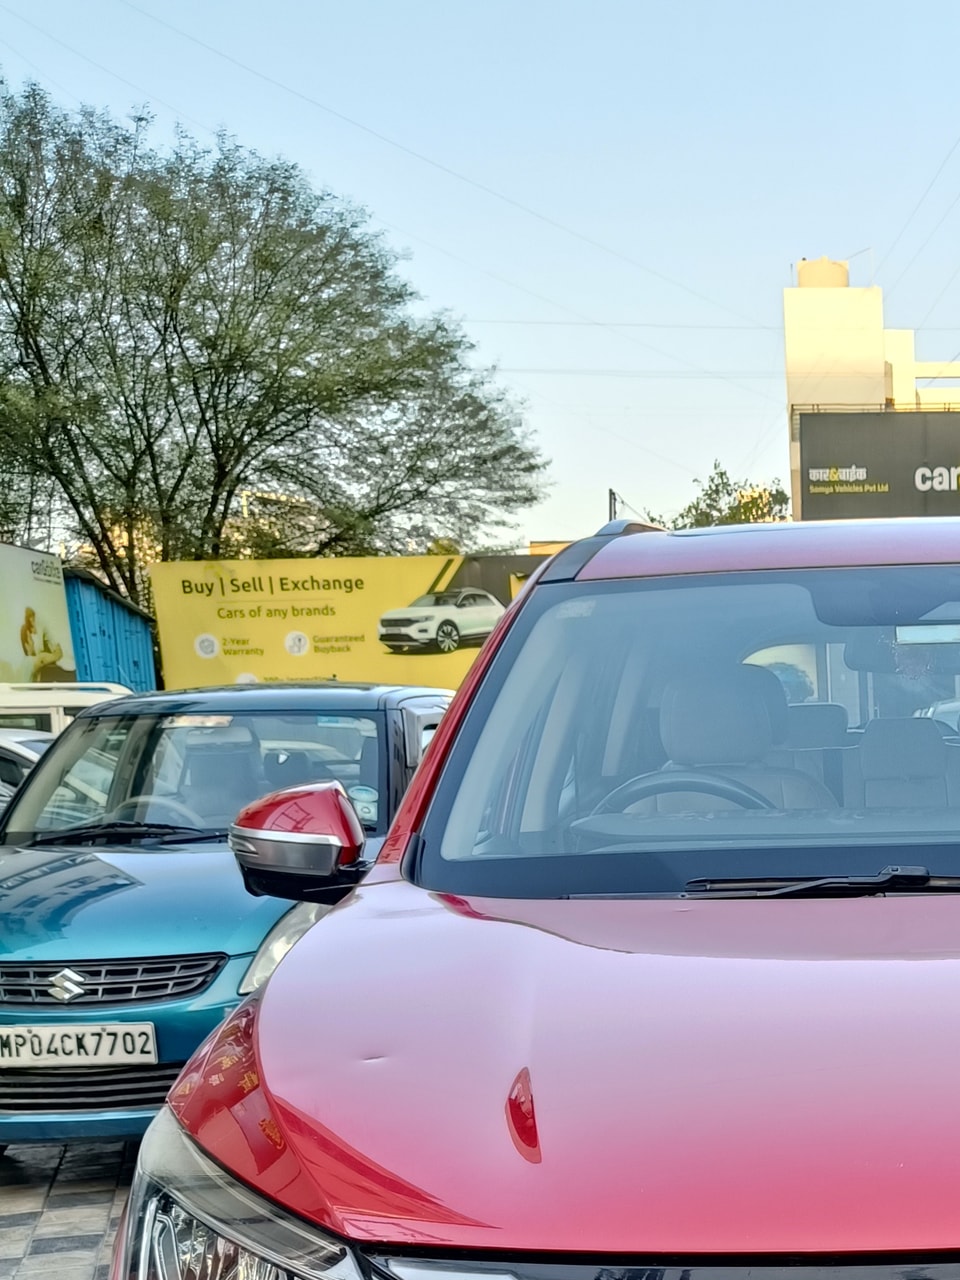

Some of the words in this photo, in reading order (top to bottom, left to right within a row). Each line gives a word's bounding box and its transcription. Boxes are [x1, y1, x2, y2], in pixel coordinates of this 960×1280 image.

[835, 482, 863, 493] Vehicles
[864, 483, 877, 493] Pvt
[877, 482, 889, 492] Ltd
[182, 579, 214, 596] Buy
[230, 577, 264, 593] Sell
[279, 576, 365, 593] Exchange
[217, 607, 246, 619] Cars
[248, 606, 262, 617] of
[265, 608, 288, 619] any
[291, 605, 336, 617] brands
[222, 638, 250, 646] 2-Year
[312, 635, 366, 644] Guaranteed
[223, 647, 265, 657] Warranty
[313, 645, 352, 654] Buyback
[0, 1031, 153, 1058] MP04CK7702
